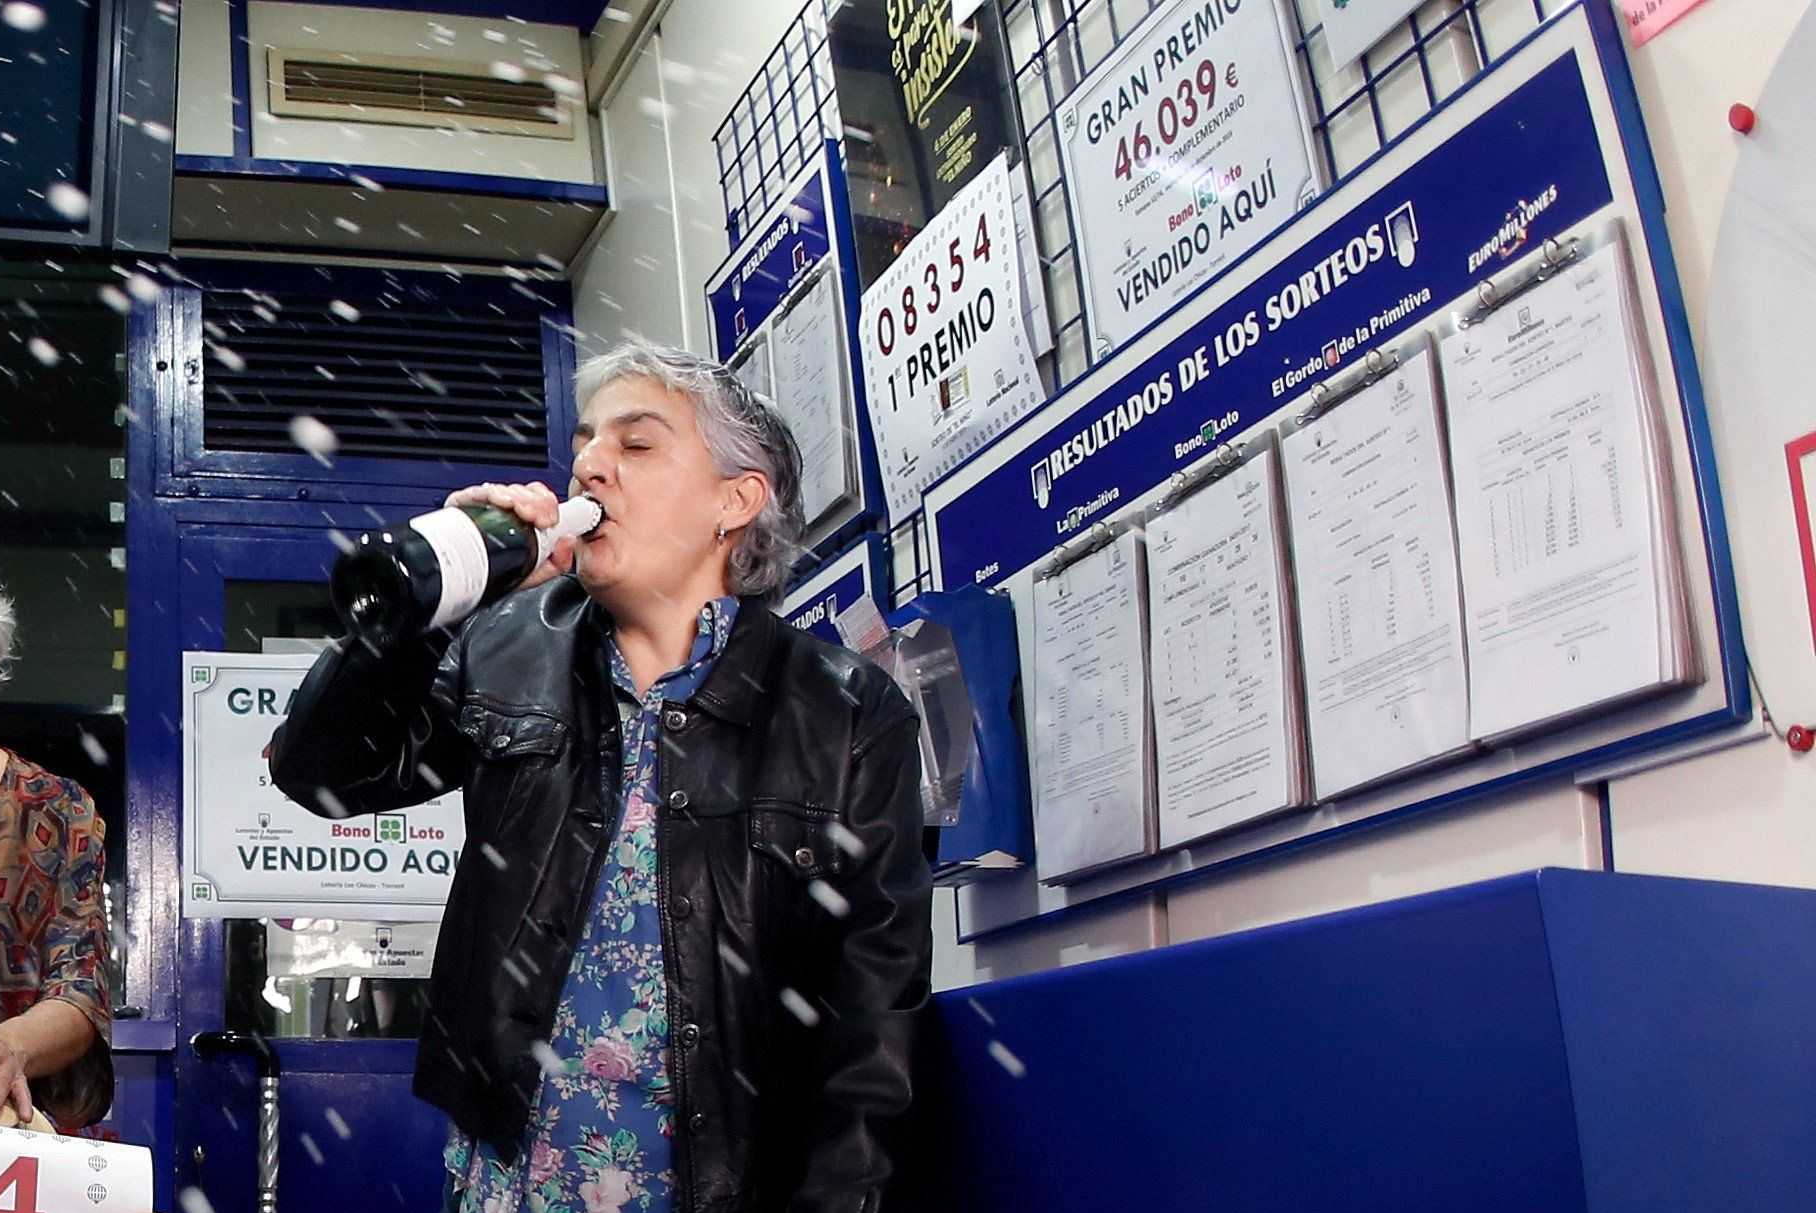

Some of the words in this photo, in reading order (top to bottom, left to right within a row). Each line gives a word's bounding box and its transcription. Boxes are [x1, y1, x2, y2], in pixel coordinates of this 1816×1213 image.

[1631, 11, 1646, 26] de
[1646, 1, 1658, 15] la
[1087, 65, 1149, 145] GRAN
[1115, 58, 1216, 182] 46.039
[1225, 62, 1240, 88] €
[1117, 199, 1124, 212] 5
[1124, 169, 1161, 208] ACIERTOS
[1168, 94, 1245, 167] COMPLEMENTARIO
[1168, 203, 1194, 232] Bono
[1219, 165, 1242, 193] Loto
[742, 218, 790, 282] RESULTADOS
[1117, 222, 1211, 313] VENDIDO
[1219, 158, 1276, 240] AQUÍ
[906, 287, 995, 398] PREMIO
[1050, 372, 1174, 481] RESULTADOS
[1178, 346, 1211, 392] DE
[1214, 310, 1260, 367] LOS
[1265, 223, 1384, 332] SORTEOS
[1271, 379, 1285, 397] El
[1285, 357, 1322, 388] Gordo
[1339, 336, 1356, 355] de
[1357, 327, 1369, 346] la
[1369, 287, 1431, 336] Primitiva
[1174, 434, 1202, 459] Bono
[1214, 410, 1240, 434] Loto
[1056, 518, 1069, 533] La
[1079, 487, 1120, 520] Primitiva
[975, 560, 999, 584] Botes
[237, 846, 389, 872] VENDIDO
[332, 823, 371, 838] Bono
[409, 825, 445, 839] Loto
